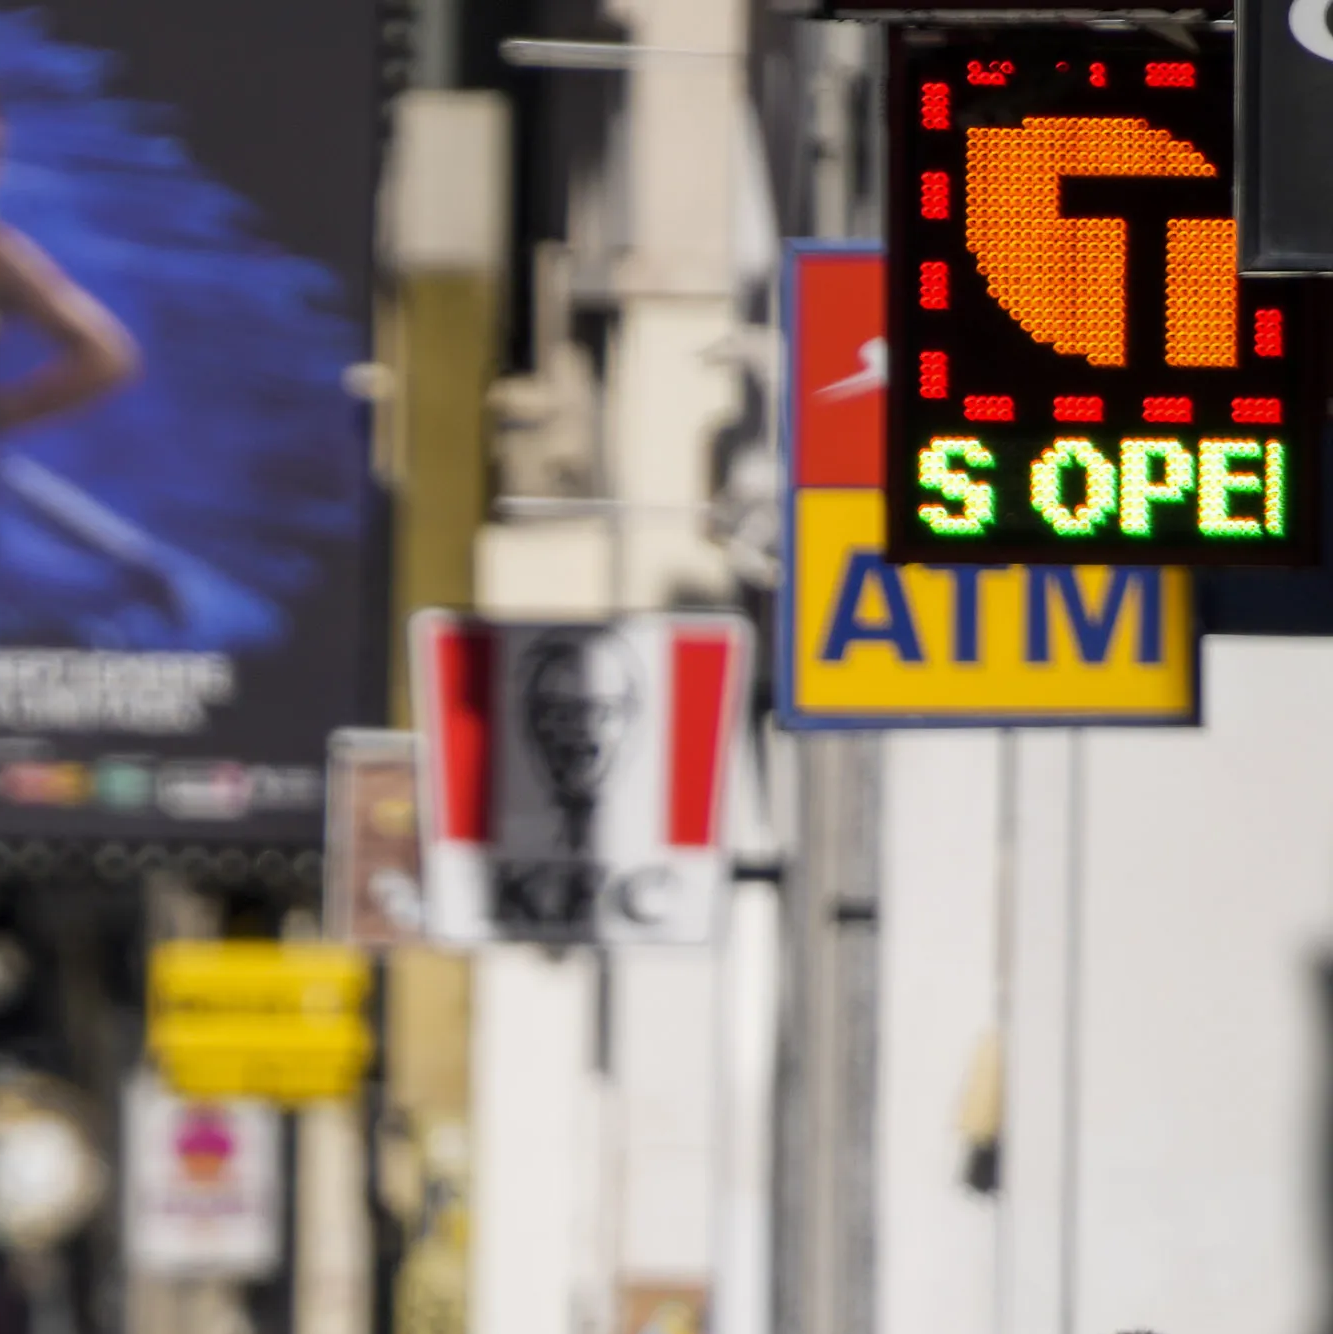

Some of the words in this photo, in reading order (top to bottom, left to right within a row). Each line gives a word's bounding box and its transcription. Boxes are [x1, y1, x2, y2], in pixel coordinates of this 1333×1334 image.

[919, 436, 995, 536] S
[1030, 436, 1286, 537] OPE
[820, 551, 1163, 664] ATM
